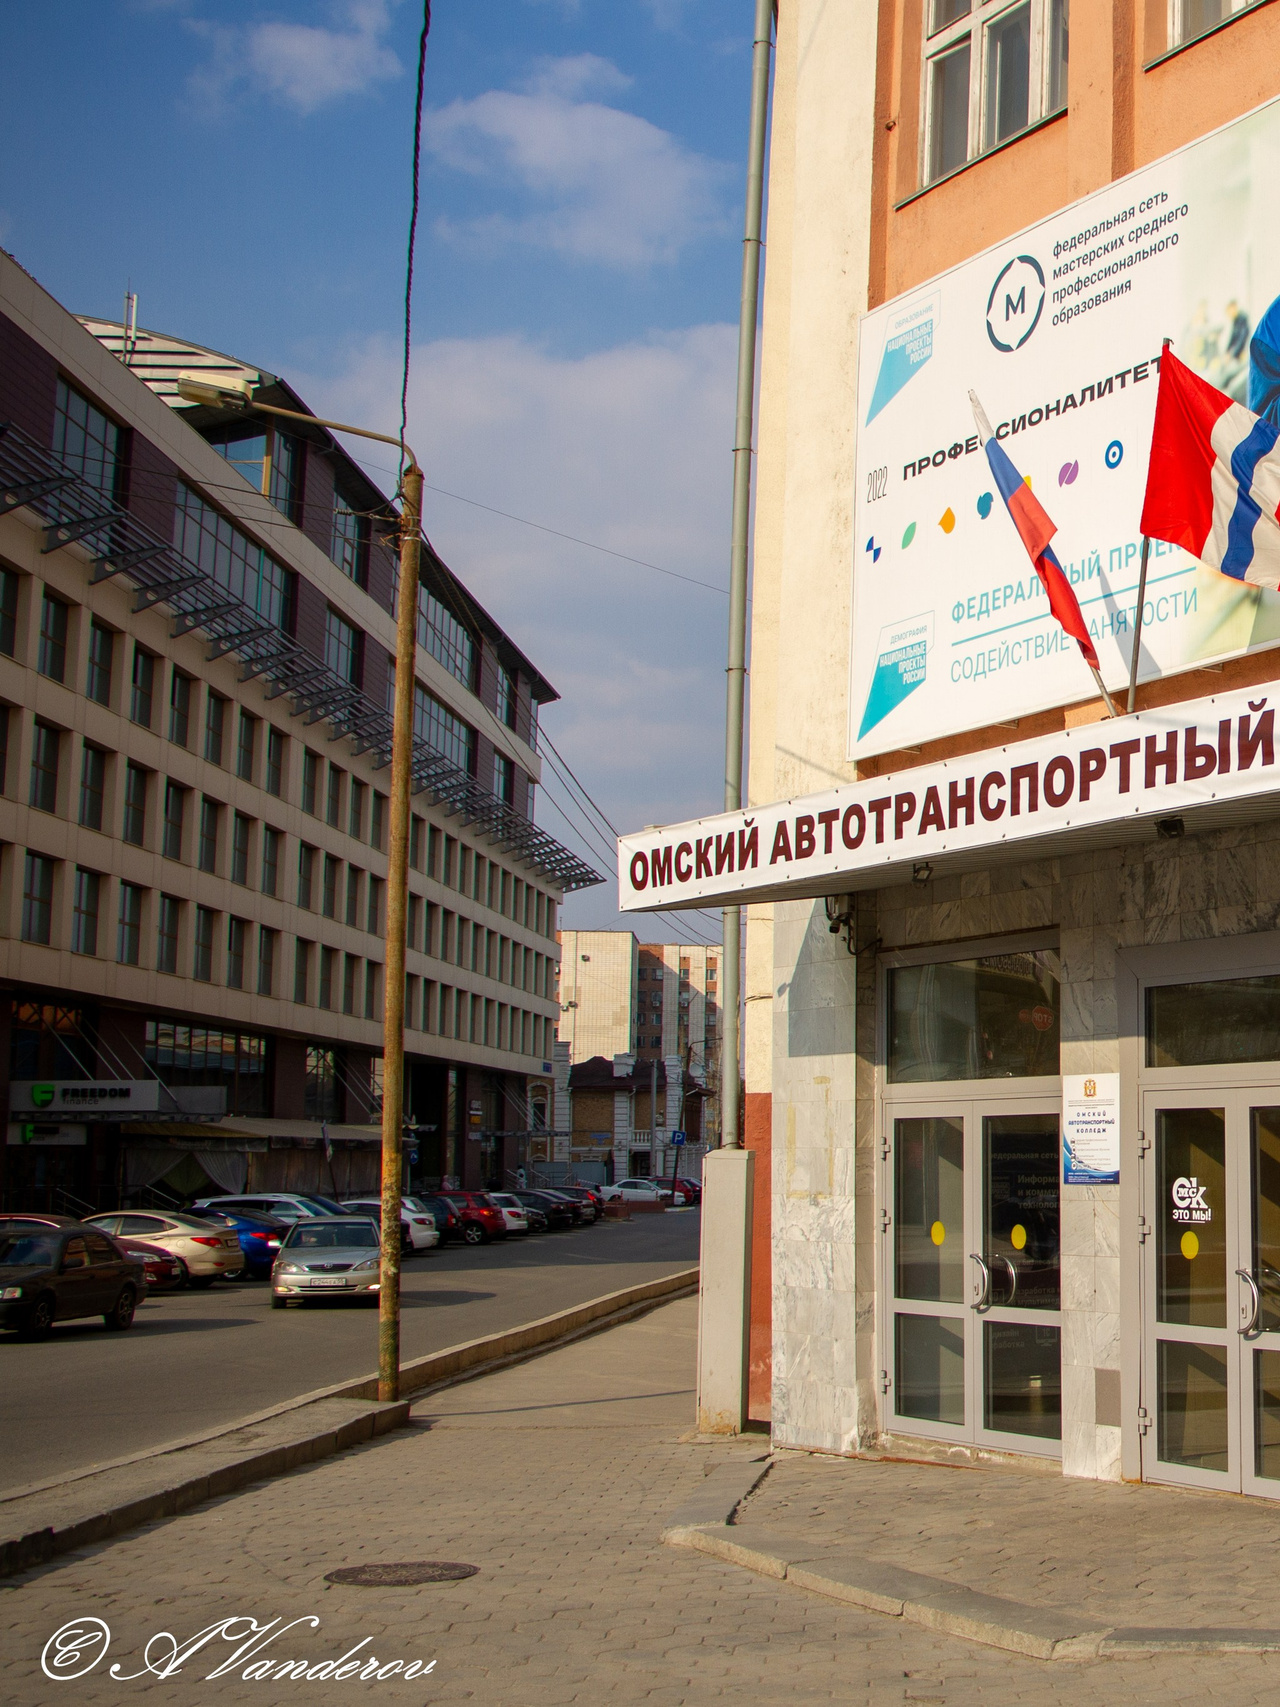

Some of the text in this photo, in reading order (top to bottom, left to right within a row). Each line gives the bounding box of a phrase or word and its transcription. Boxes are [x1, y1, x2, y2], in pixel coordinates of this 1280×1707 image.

[1053, 192, 1168, 260] федеральная сеть
[1053, 204, 1189, 280] мастерских среднего
[1052, 233, 1179, 304] профессионального
[1052, 279, 1132, 326] образования
[894, 303, 934, 329] ОБРАЗОВАНИЕ
[887, 320, 933, 353] НАЦИОНАЛЬНЫЕ
[905, 332, 933, 355] ПРОЕКТЫ
[910, 344, 932, 365] РОССИИ
[903, 355, 1162, 481] ПРОФЕСИОНАЛИТЕТ
[866, 465, 888, 503] 2022
[951, 549, 1101, 624] ФЕДЕРАЛЫЙ
[890, 625, 928, 645] ДЕМОГРАФИЯ
[950, 587, 1197, 683] СОДЕЙСТВИЕ АНЯТОСТИ
[879, 642, 926, 668] НАЦИОНАЛЬНЫЕ
[898, 655, 926, 674] ПРОЕКТЫ
[903, 667, 926, 685] РОССИИ
[629, 818, 759, 891] ОМСКИЙ
[769, 698, 1275, 865] АВТОТРАНСПОРТНЫЙ
[61, 1088, 131, 1098] FREEDOM
[62, 1096, 99, 1105] finance
[1068, 1118, 1115, 1126] АВТОТРАНСПОРТНЫЙ
[674, 1133, 682, 1142] P
[1172, 1209, 1190, 1219] ЭТО
